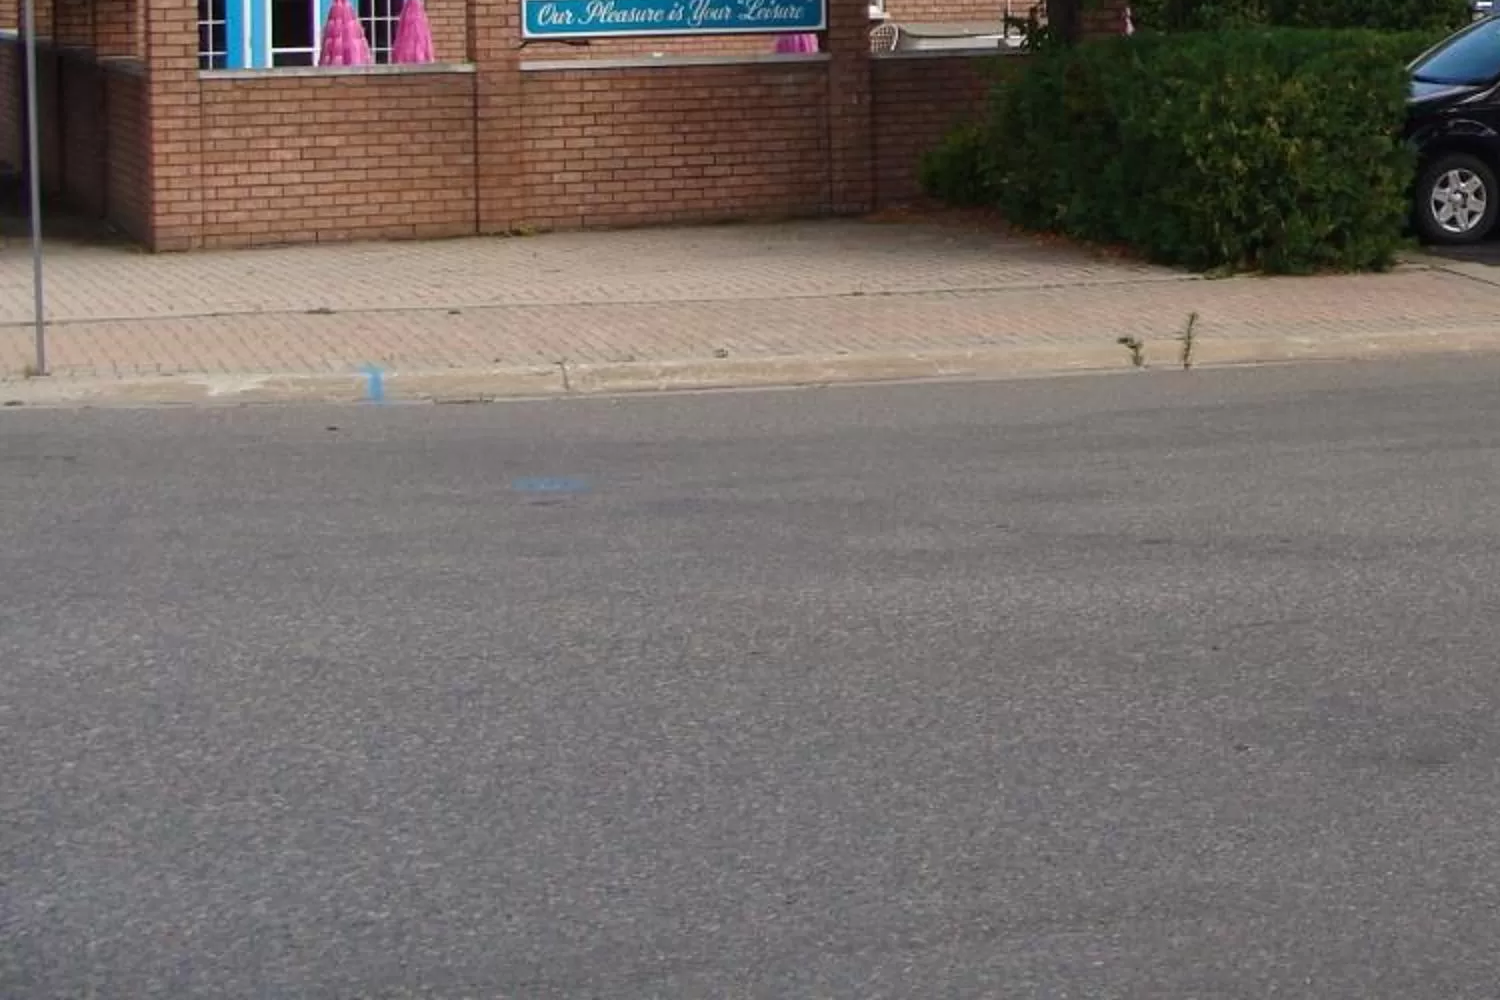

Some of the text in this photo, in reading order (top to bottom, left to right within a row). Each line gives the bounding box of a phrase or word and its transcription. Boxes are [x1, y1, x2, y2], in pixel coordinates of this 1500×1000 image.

[537, 2, 575, 26] Our
[577, 0, 664, 24] Pleasure
[667, 1, 684, 21] is
